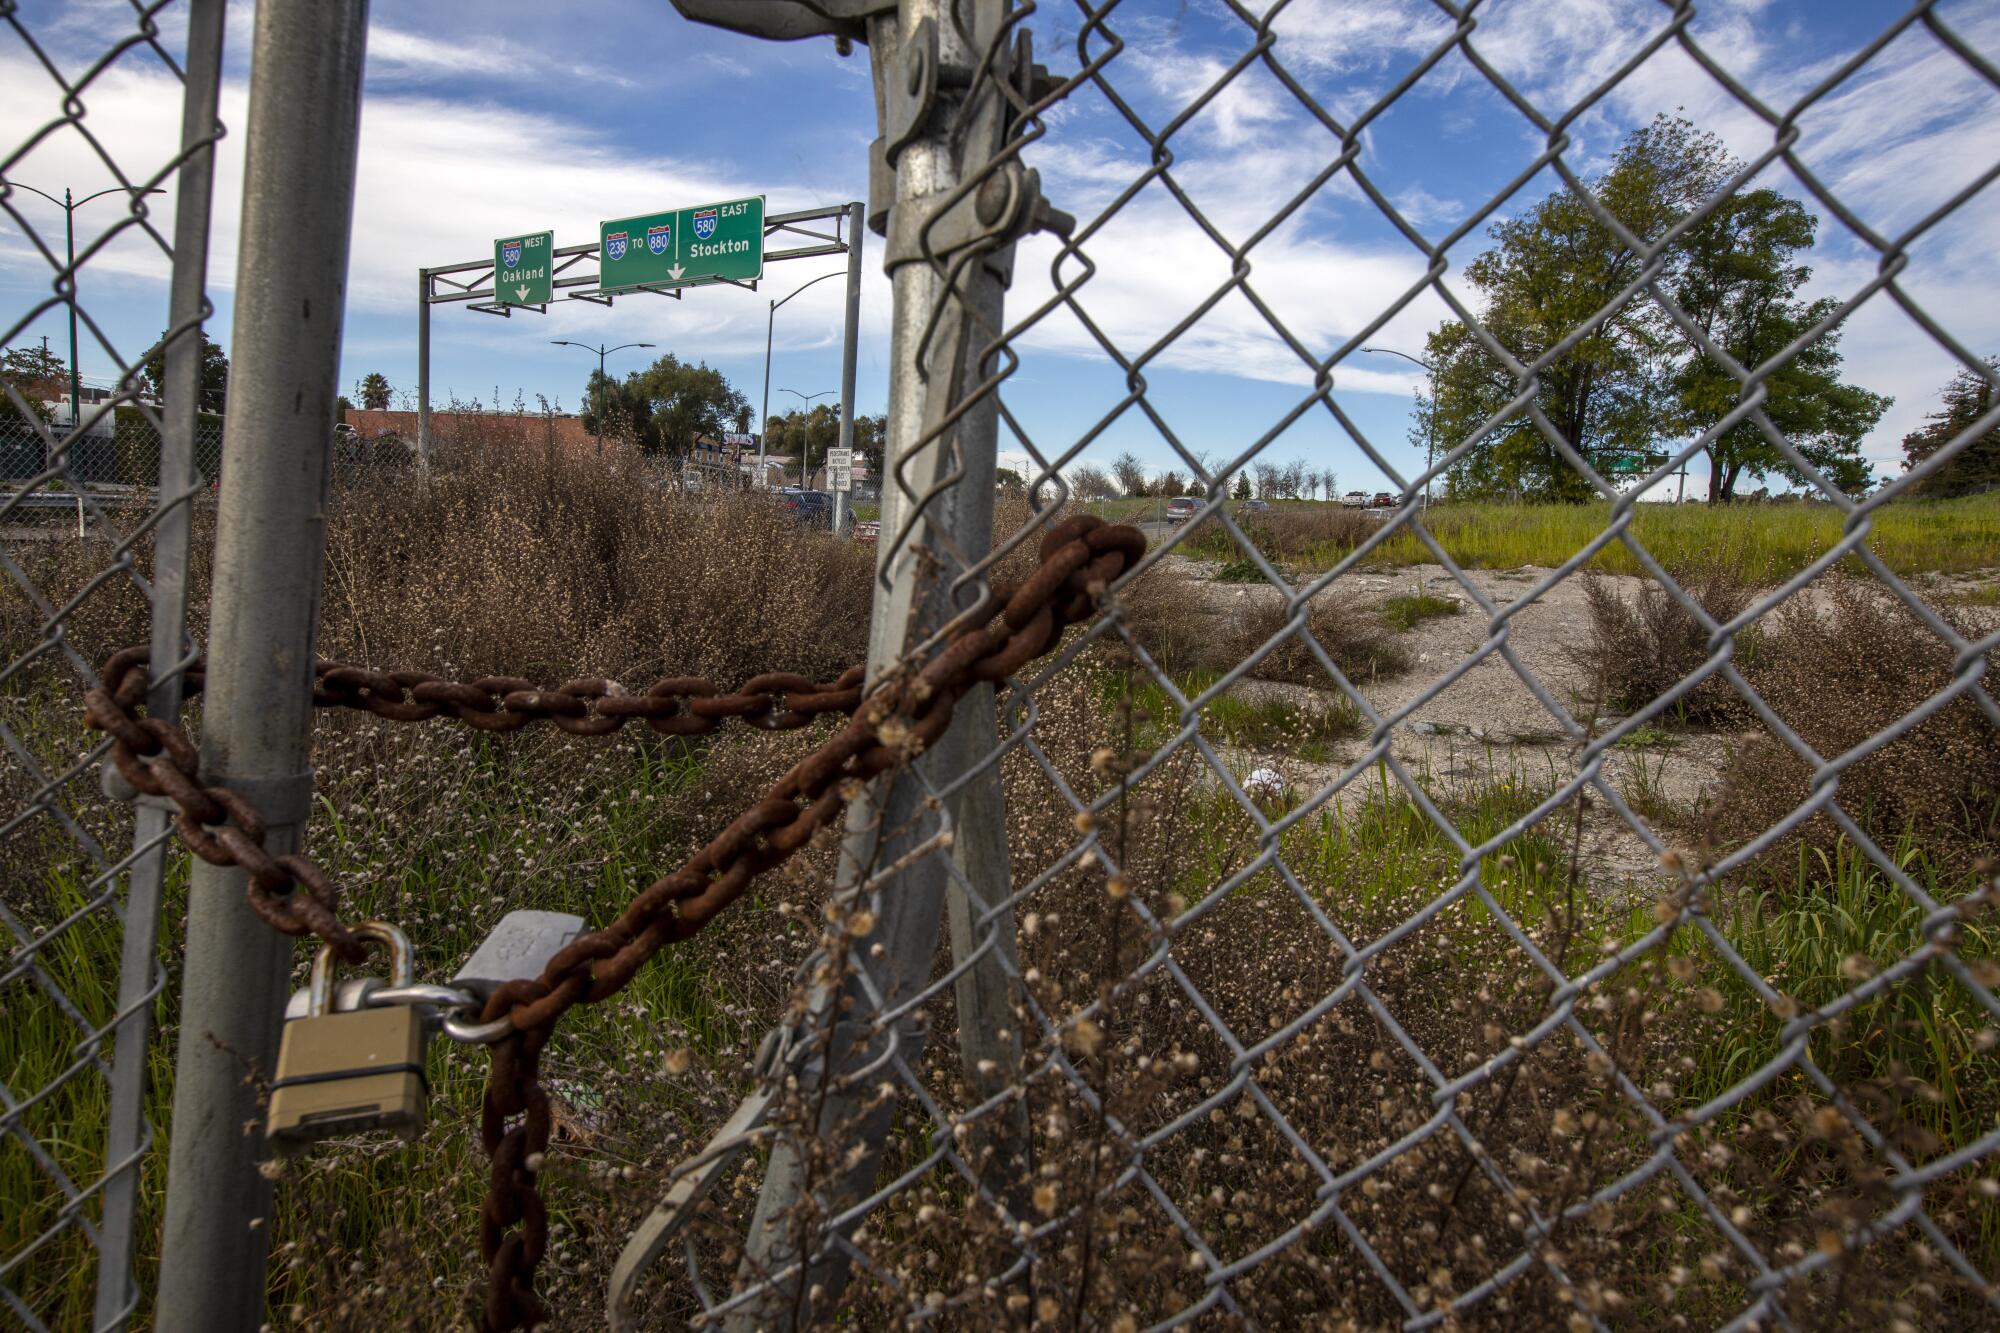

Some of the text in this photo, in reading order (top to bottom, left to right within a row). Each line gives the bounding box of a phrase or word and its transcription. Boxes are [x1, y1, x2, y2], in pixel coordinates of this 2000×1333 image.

[697, 219, 715, 234] 580
[721, 203, 749, 218] EAST
[505, 249, 519, 263] 580
[524, 236, 545, 249] WEST
[609, 234, 668, 255] 238 TO 880
[690, 239, 749, 258] Stockton
[502, 265, 544, 283] Oakland
